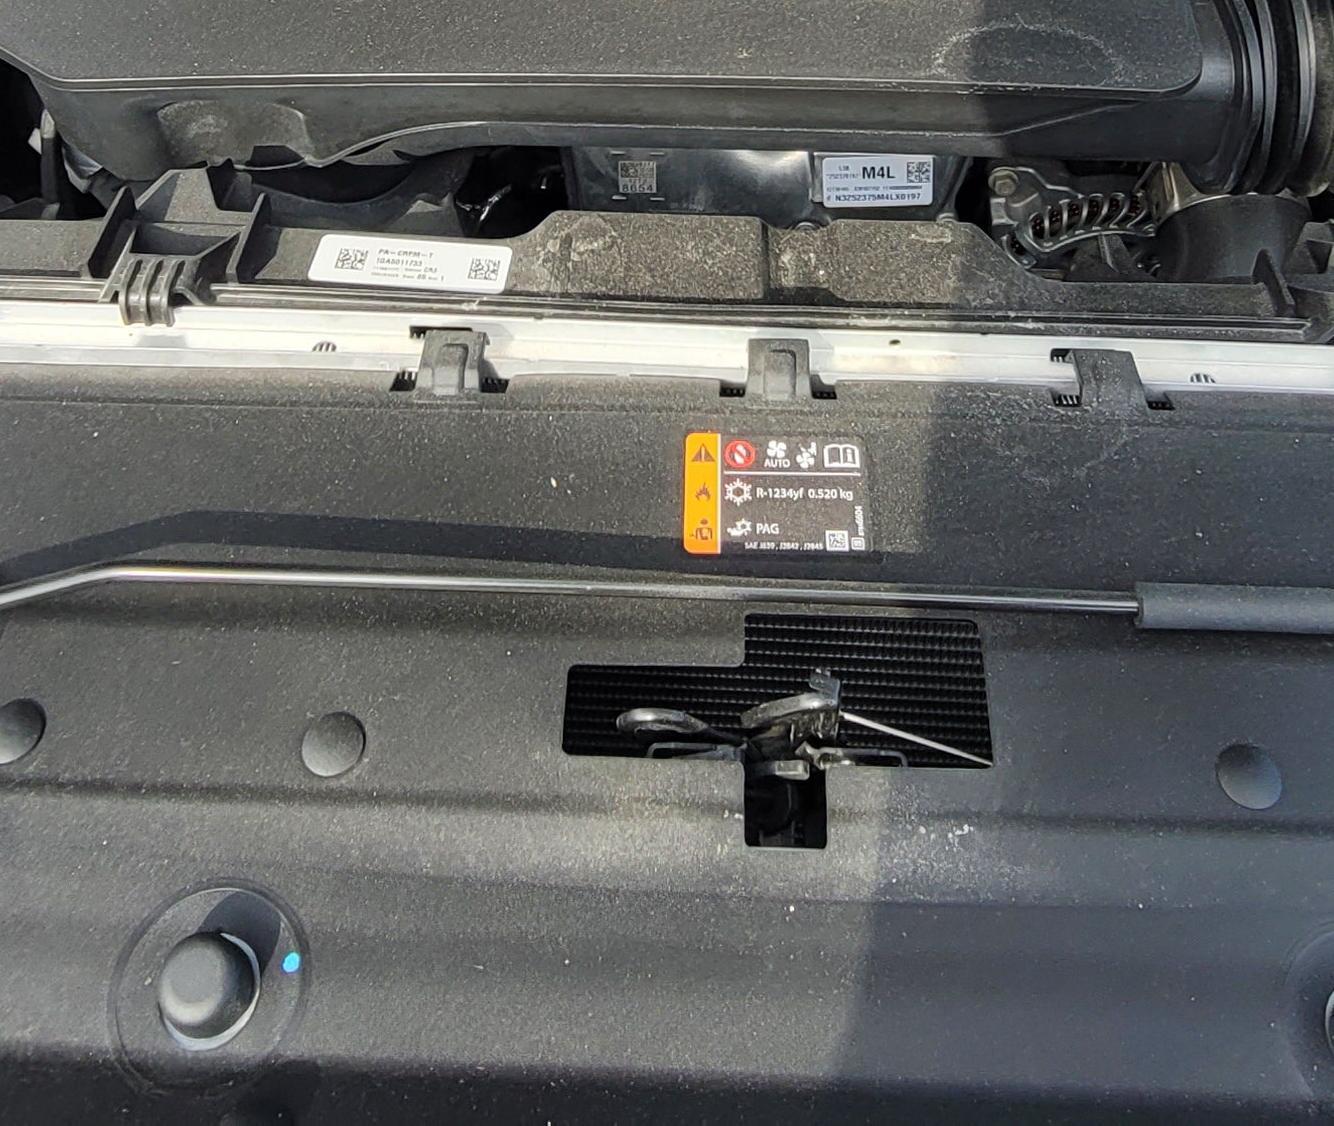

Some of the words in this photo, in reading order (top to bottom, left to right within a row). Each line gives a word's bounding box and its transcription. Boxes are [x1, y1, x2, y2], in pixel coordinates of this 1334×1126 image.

[862, 166, 896, 179] M4L
[764, 458, 791, 469] AUTO
[756, 487, 804, 501] R-1234yf
[807, 488, 837, 499] 0.520
[839, 487, 854, 501] kg
[755, 523, 780, 534] PAG
